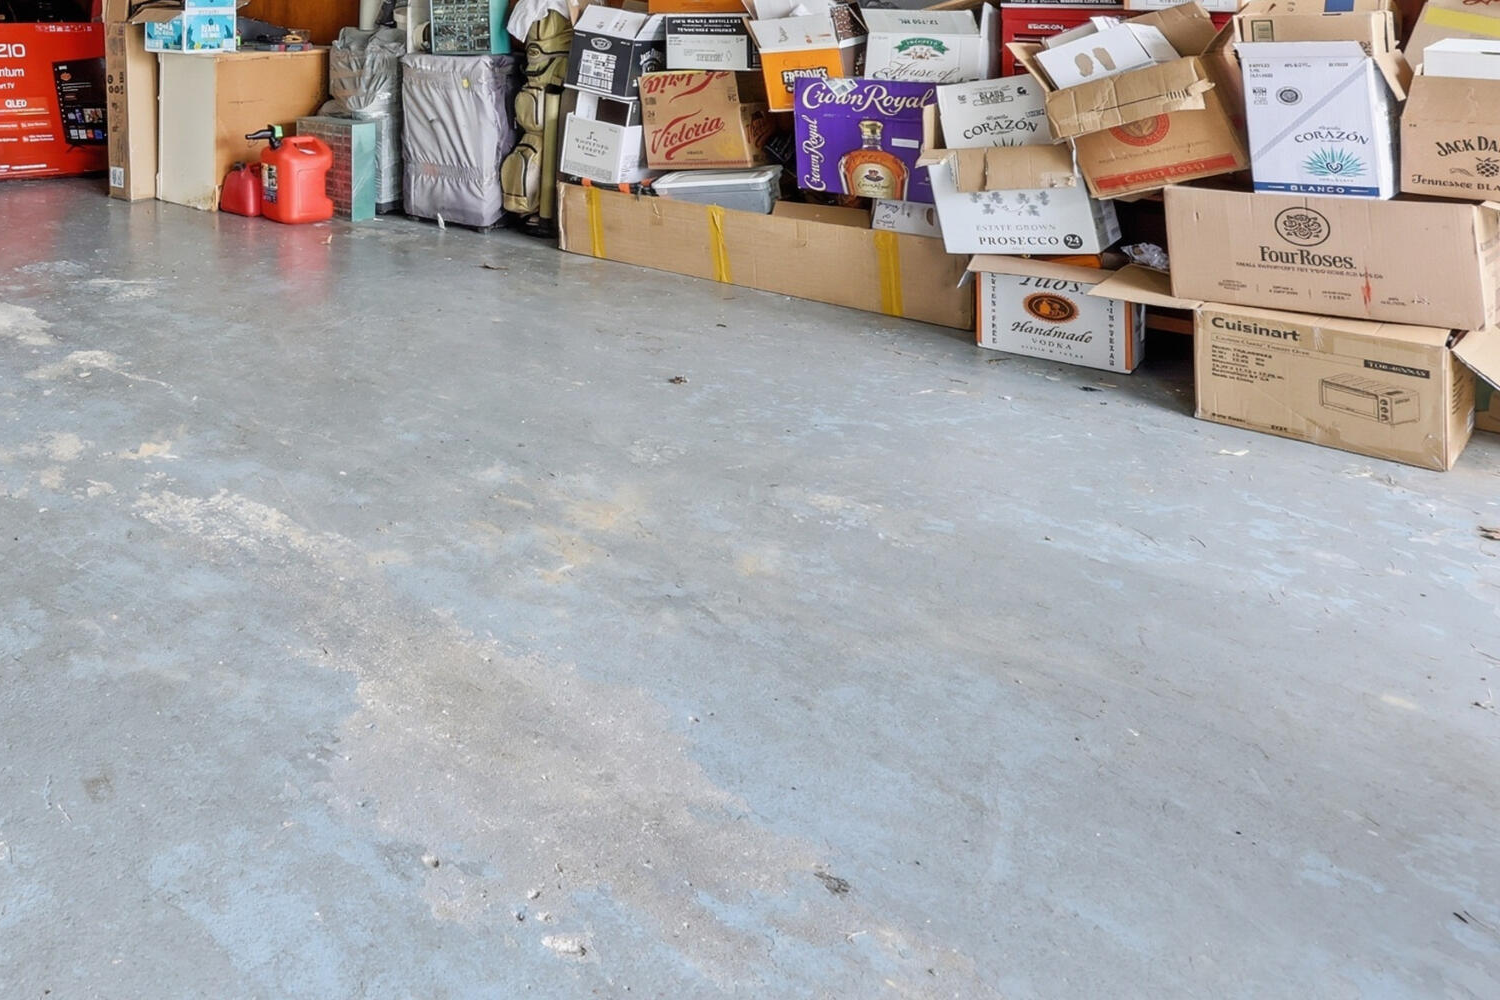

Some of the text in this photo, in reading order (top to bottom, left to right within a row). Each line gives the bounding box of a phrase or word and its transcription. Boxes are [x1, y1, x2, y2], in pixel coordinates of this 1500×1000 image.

[5, 99, 28, 108] QLED
[802, 82, 938, 116] Crown Royal
[651, 109, 725, 160] Victoria
[802, 115, 825, 162] Royal
[963, 117, 1038, 140] CORAZÓN
[1294, 131, 1369, 145] CORAZÓN
[1435, 135, 1500, 157] JACK DA
[803, 152, 826, 191] Crown
[1124, 171, 1165, 184] CARLO
[1411, 174, 1473, 189] Tennessee
[1290, 185, 1345, 194] BLANCO
[979, 235, 1059, 246] PROSECCO
[1259, 245, 1298, 264] Four
[1011, 320, 1093, 344] Handmade
[1211, 316, 1300, 341] Cuisinart
[1031, 338, 1073, 350] VODKA
